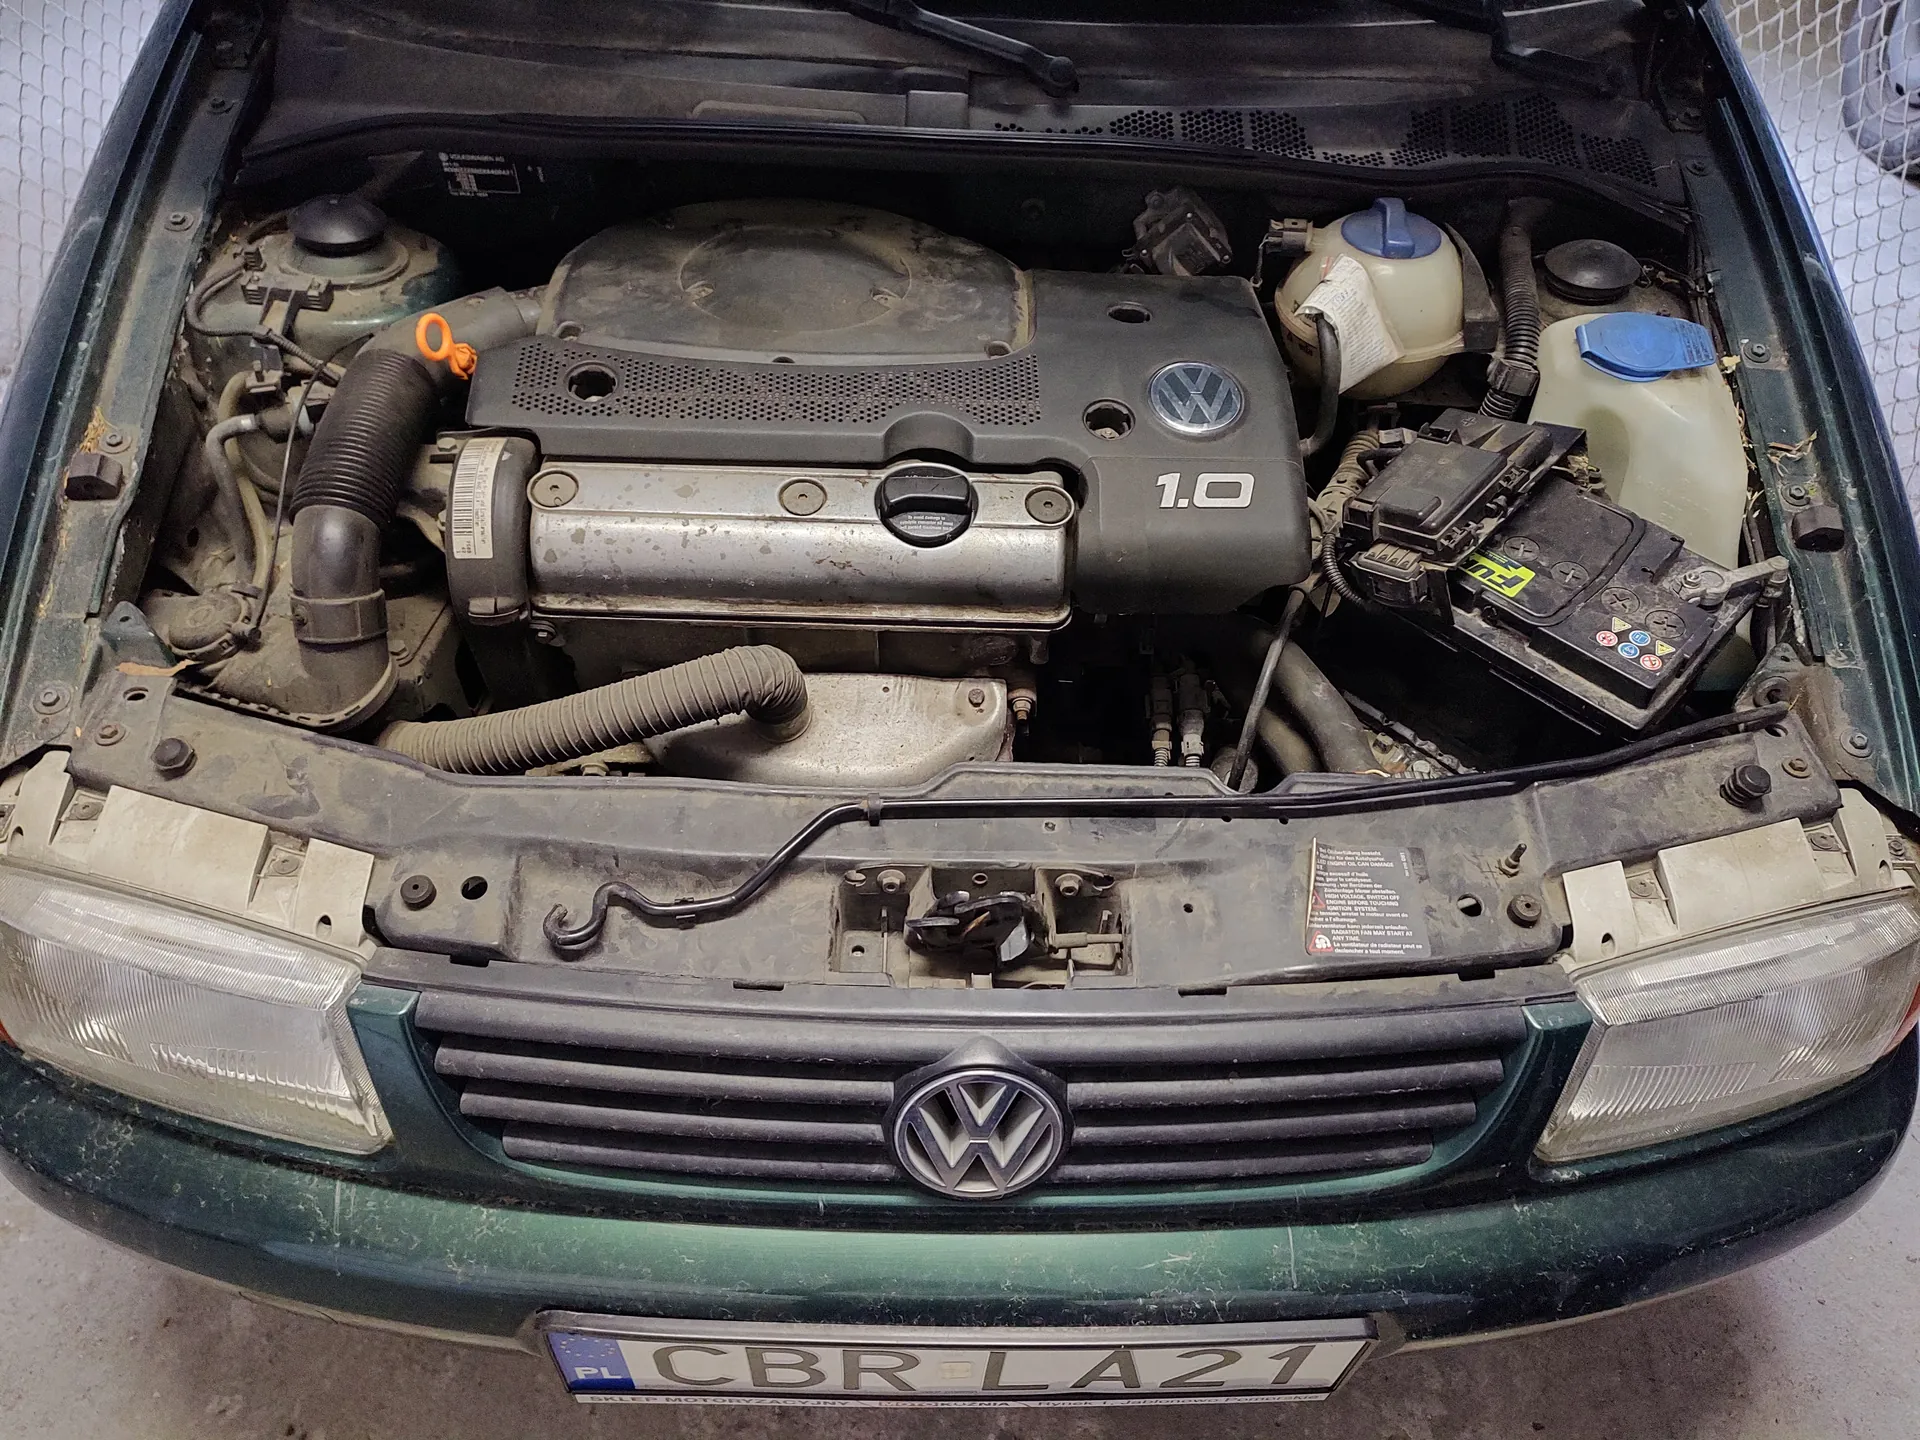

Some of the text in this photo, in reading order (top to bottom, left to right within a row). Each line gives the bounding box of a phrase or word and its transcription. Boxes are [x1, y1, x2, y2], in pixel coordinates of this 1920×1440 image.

[1155, 472, 1256, 509] 1.0
[574, 1366, 622, 1379] PL
[652, 1344, 1317, 1392] CBR LA21
[664, 1397, 849, 1406] MOTORYZACYJNY
